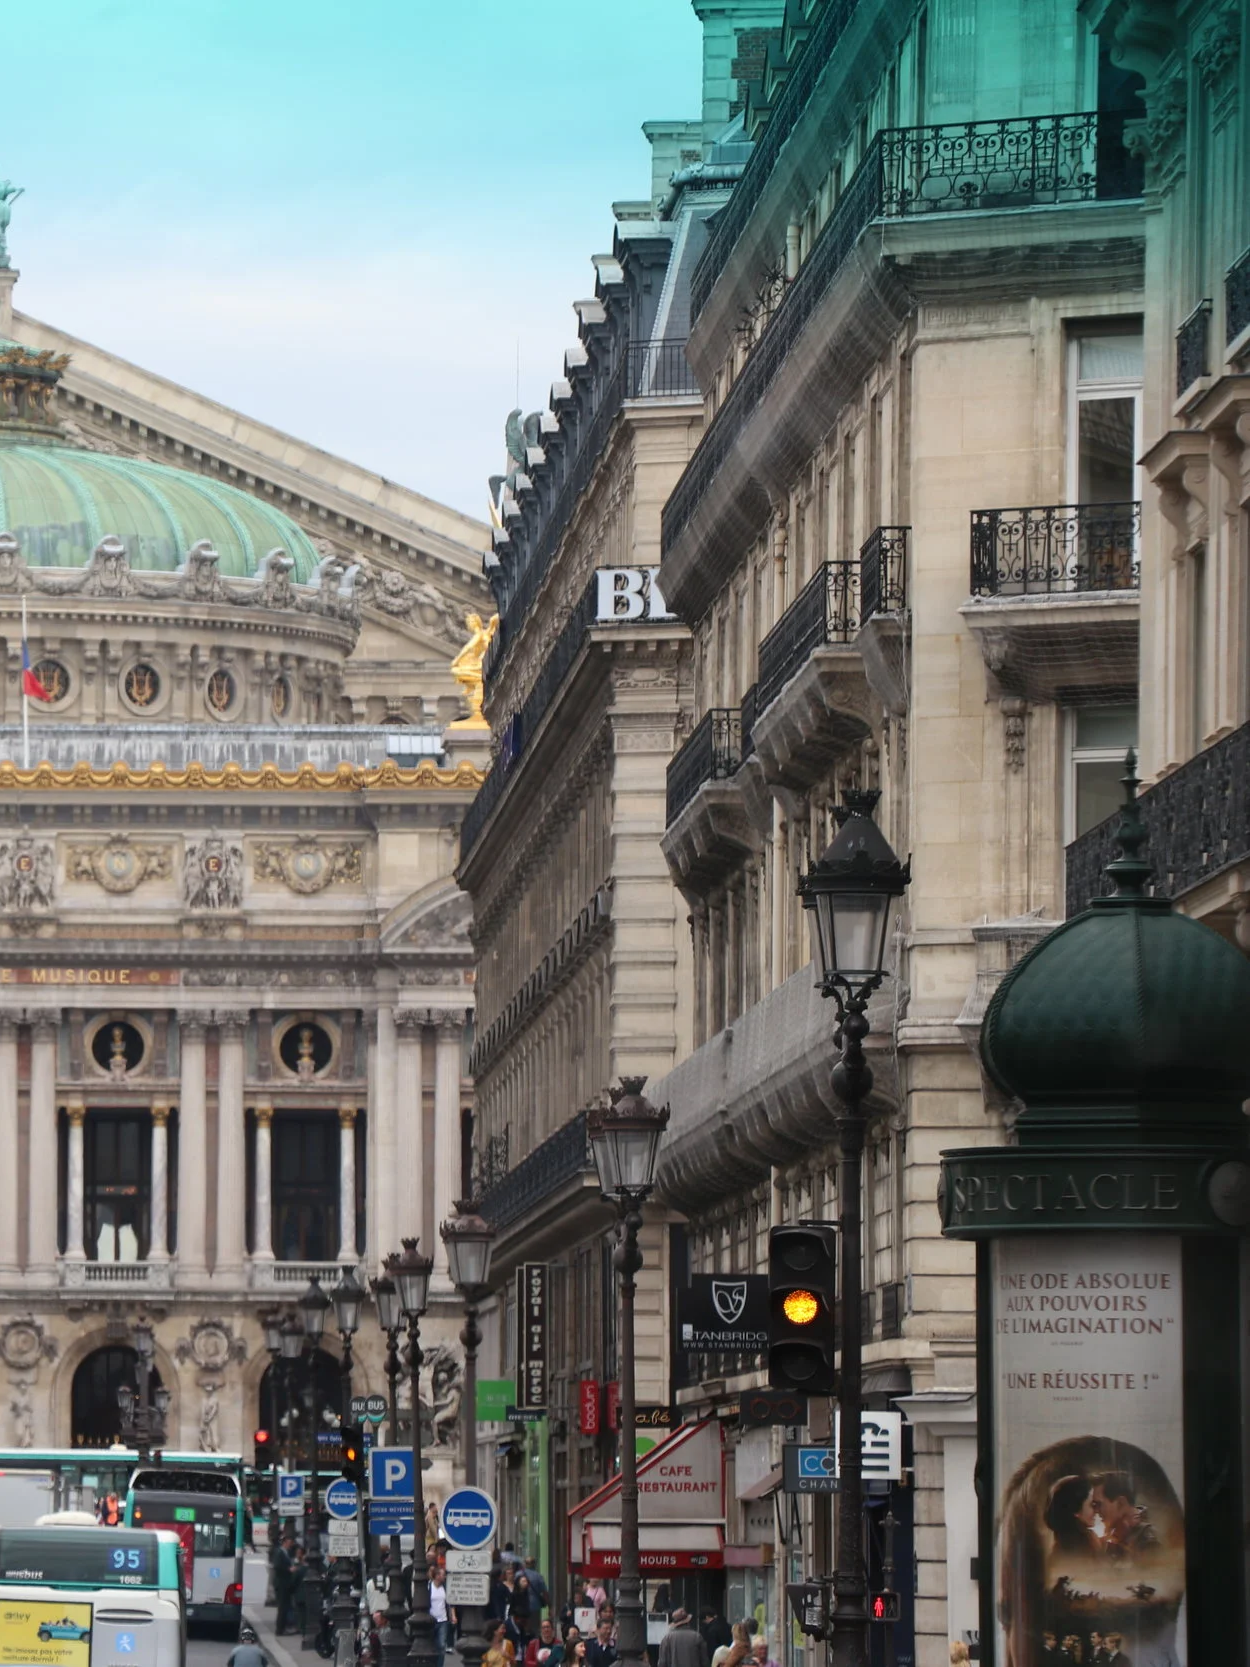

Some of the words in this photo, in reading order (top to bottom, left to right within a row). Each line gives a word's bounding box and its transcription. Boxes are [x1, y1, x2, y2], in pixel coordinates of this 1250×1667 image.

[31, 968, 131, 984] MUSIQUE
[954, 1173, 1181, 1213] SPECTACLE
[1030, 1273, 1069, 1289] ODE
[1075, 1273, 1172, 1290] ABSOLUE
[530, 1268, 542, 1317] royal
[1006, 1296, 1034, 1311] AUX
[1040, 1295, 1147, 1311] POUVOIRS
[530, 1324, 542, 1352] air
[683, 1331, 768, 1341] STANBRIDG
[529, 1360, 544, 1404] maroc
[1043, 1369, 1136, 1389] RÉUSSITE
[368, 1400, 384, 1411] BUS
[385, 1459, 407, 1491] P
[660, 1466, 693, 1476] CAFE
[285, 1479, 298, 1496] P
[637, 1482, 717, 1492] RESTAURANT
[799, 1480, 838, 1489] CHAN
[113, 1549, 141, 1568] 95
[640, 1556, 677, 1565] HOURS
